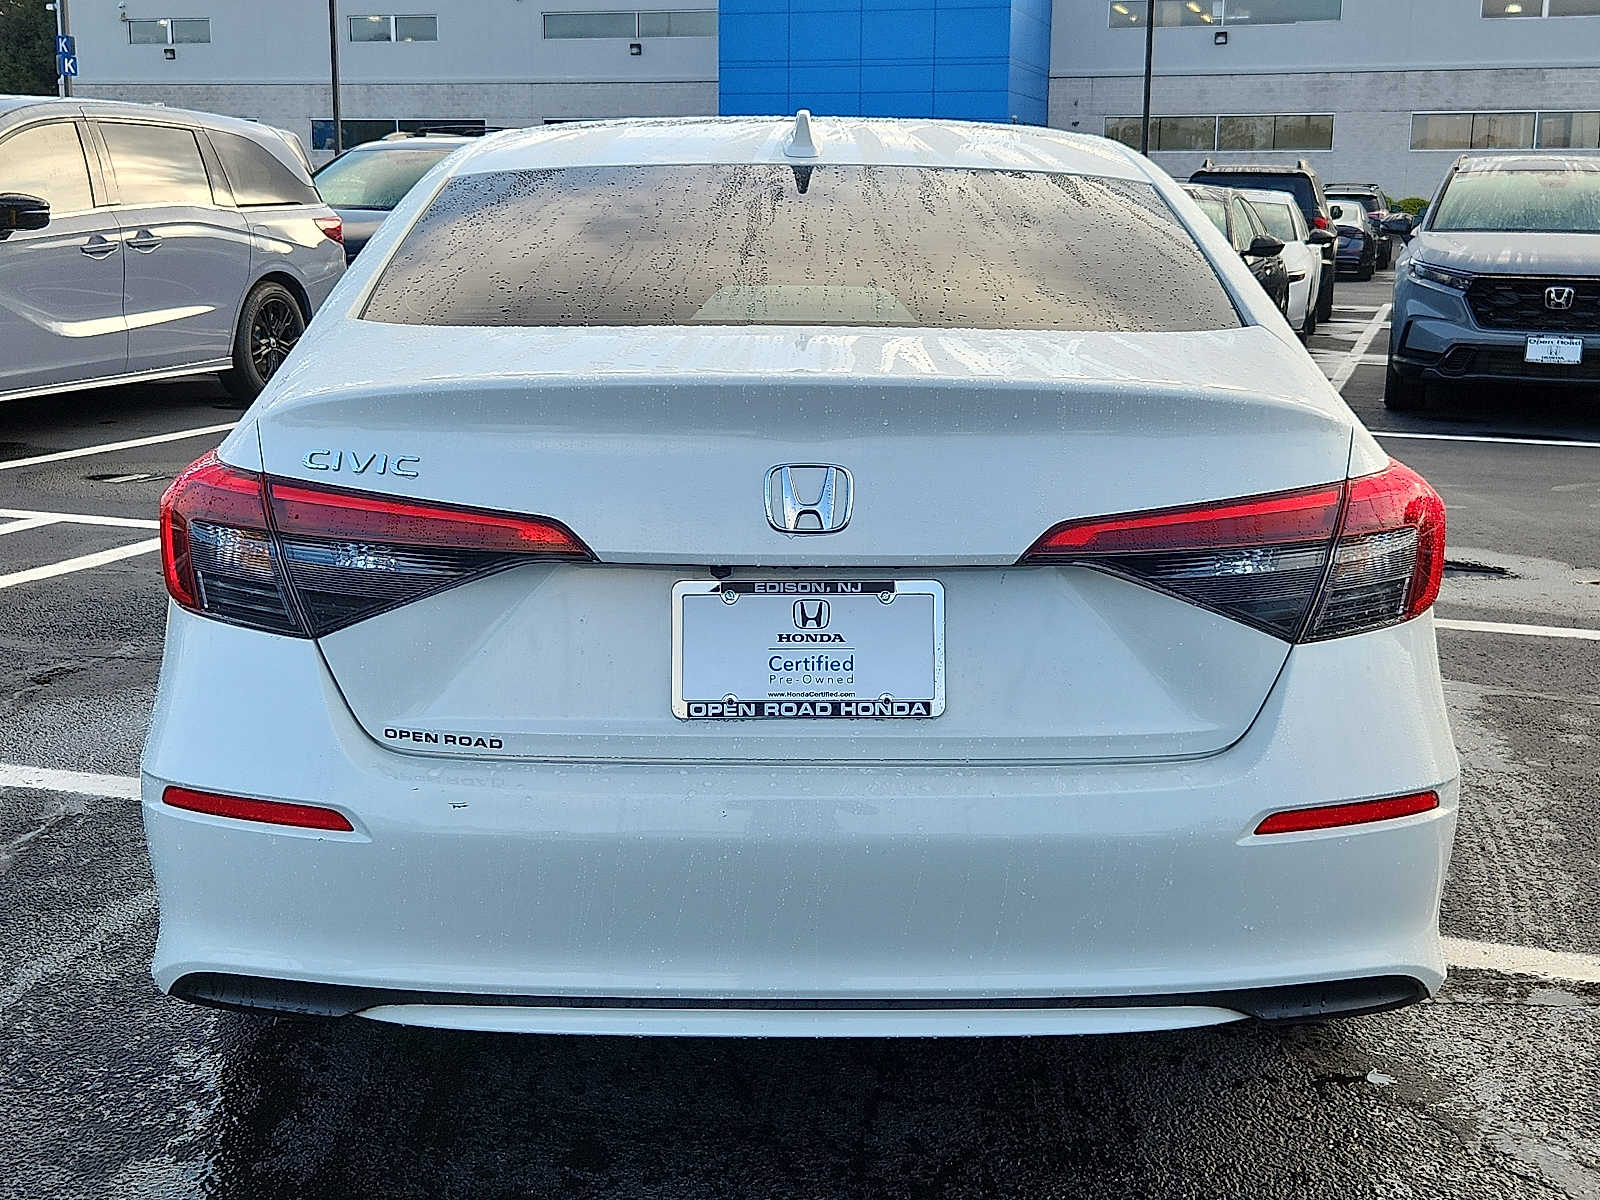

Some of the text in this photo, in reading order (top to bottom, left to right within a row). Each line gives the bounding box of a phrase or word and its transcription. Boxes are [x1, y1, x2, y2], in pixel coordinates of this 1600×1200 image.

[58, 37, 68, 52] K
[64, 57, 75, 73] K
[302, 449, 420, 478] CIVIC
[754, 582, 862, 593] EDISON, NJ
[777, 633, 846, 643] HONDA
[768, 654, 854, 672] Certified
[769, 674, 854, 684] Pre-Owned
[689, 702, 928, 717] OPEN ROAD HONDA
[384, 728, 503, 749] OPEN ROAD
